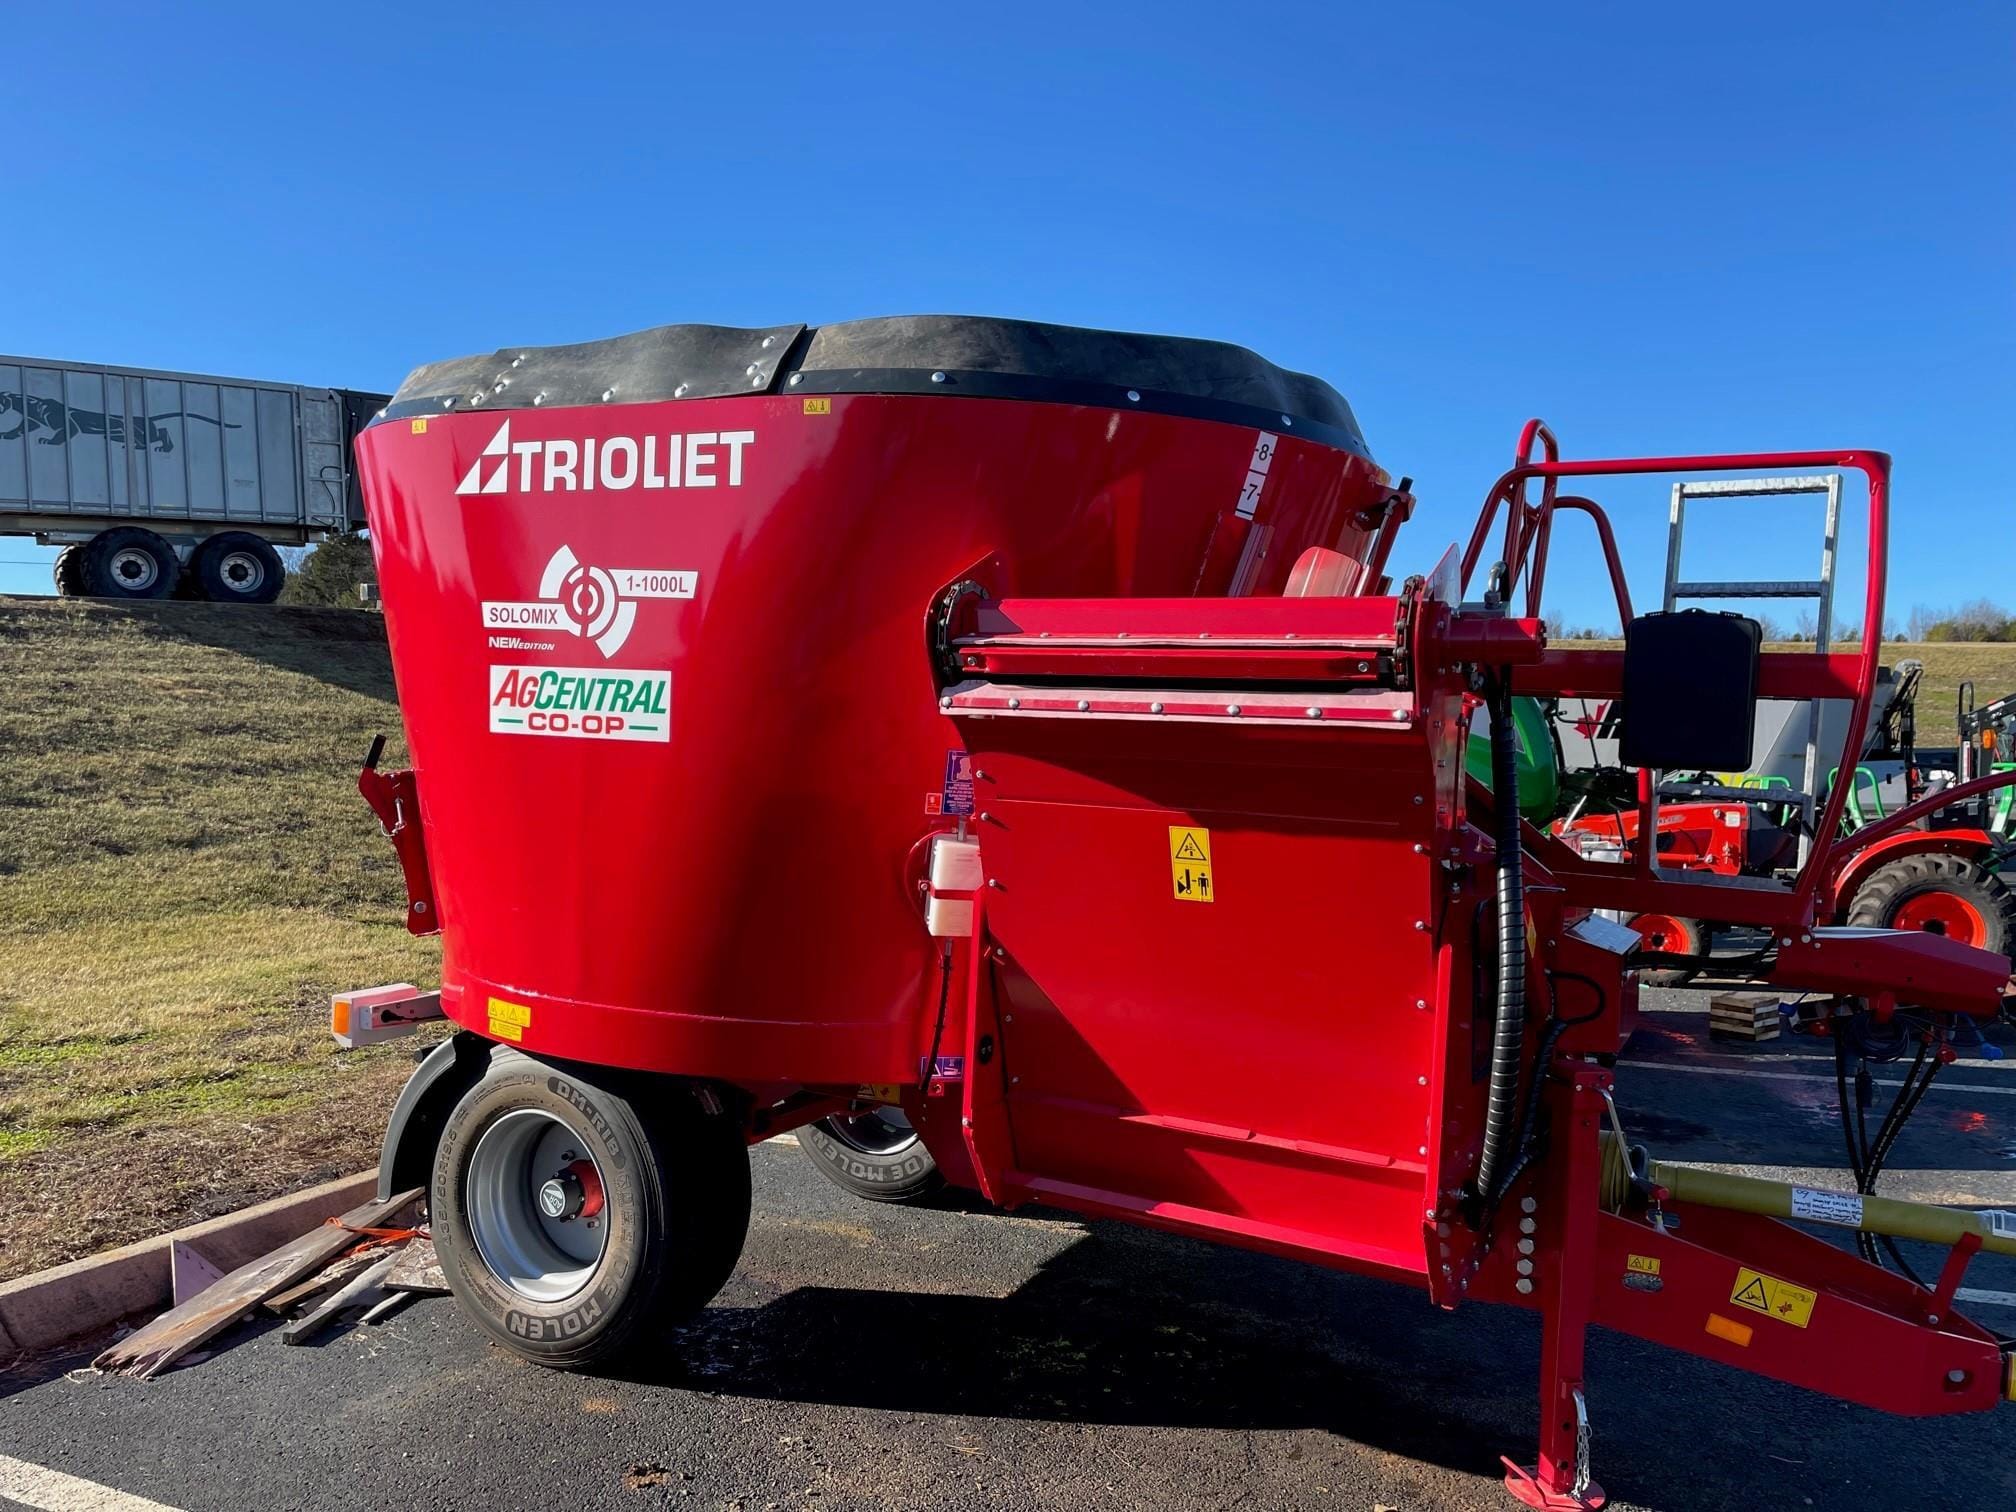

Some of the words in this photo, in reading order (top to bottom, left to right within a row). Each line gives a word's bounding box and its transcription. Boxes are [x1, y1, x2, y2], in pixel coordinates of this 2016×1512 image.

[512, 430, 755, 493] TRIOLIET
[1258, 443, 1270, 461] 8
[1246, 483, 1258, 501] 7
[626, 575, 689, 594] 1-1000L
[489, 606, 558, 625] SOLOMIX
[527, 712, 625, 735] CO-OP
[812, 1130, 884, 1182] MOLEN
[890, 1155, 922, 1177] DE
[509, 1298, 603, 1339] MOLEN
